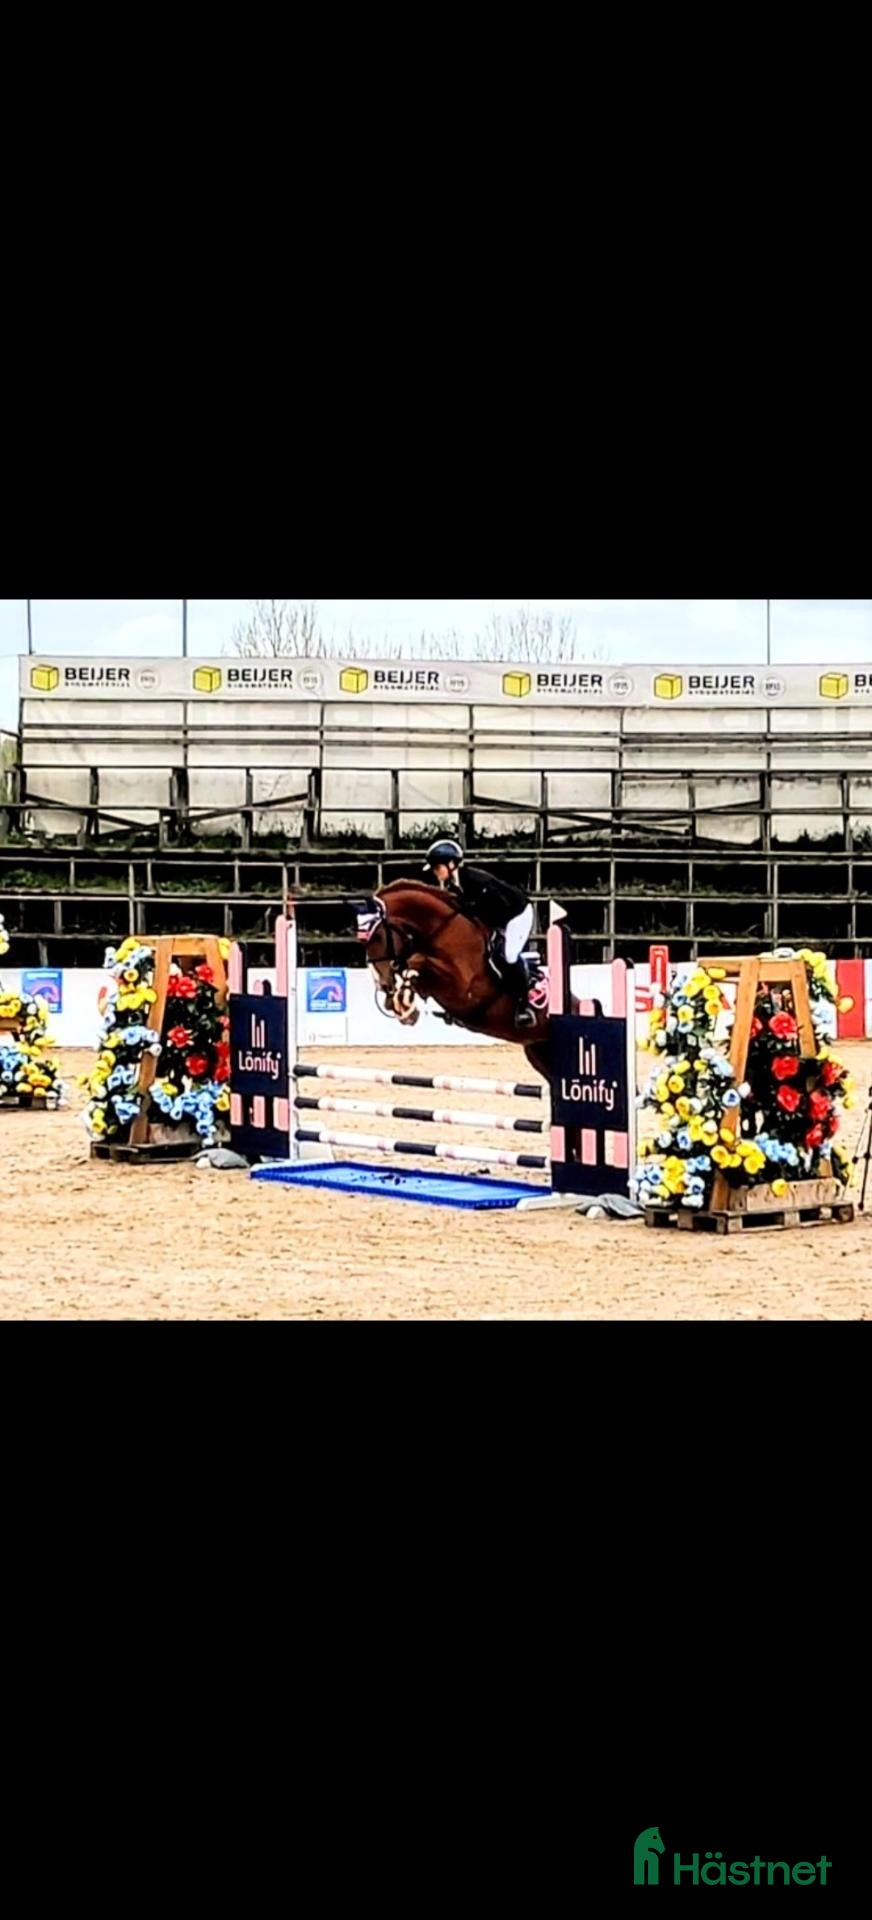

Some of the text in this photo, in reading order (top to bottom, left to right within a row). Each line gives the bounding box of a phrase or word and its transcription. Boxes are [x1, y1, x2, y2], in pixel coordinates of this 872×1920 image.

[65, 667, 130, 681] BEIJER
[227, 668, 293, 682] BEIJER
[374, 670, 439, 684] BEIJER
[537, 673, 603, 687] BEIJER
[688, 675, 755, 689] BEIJER
